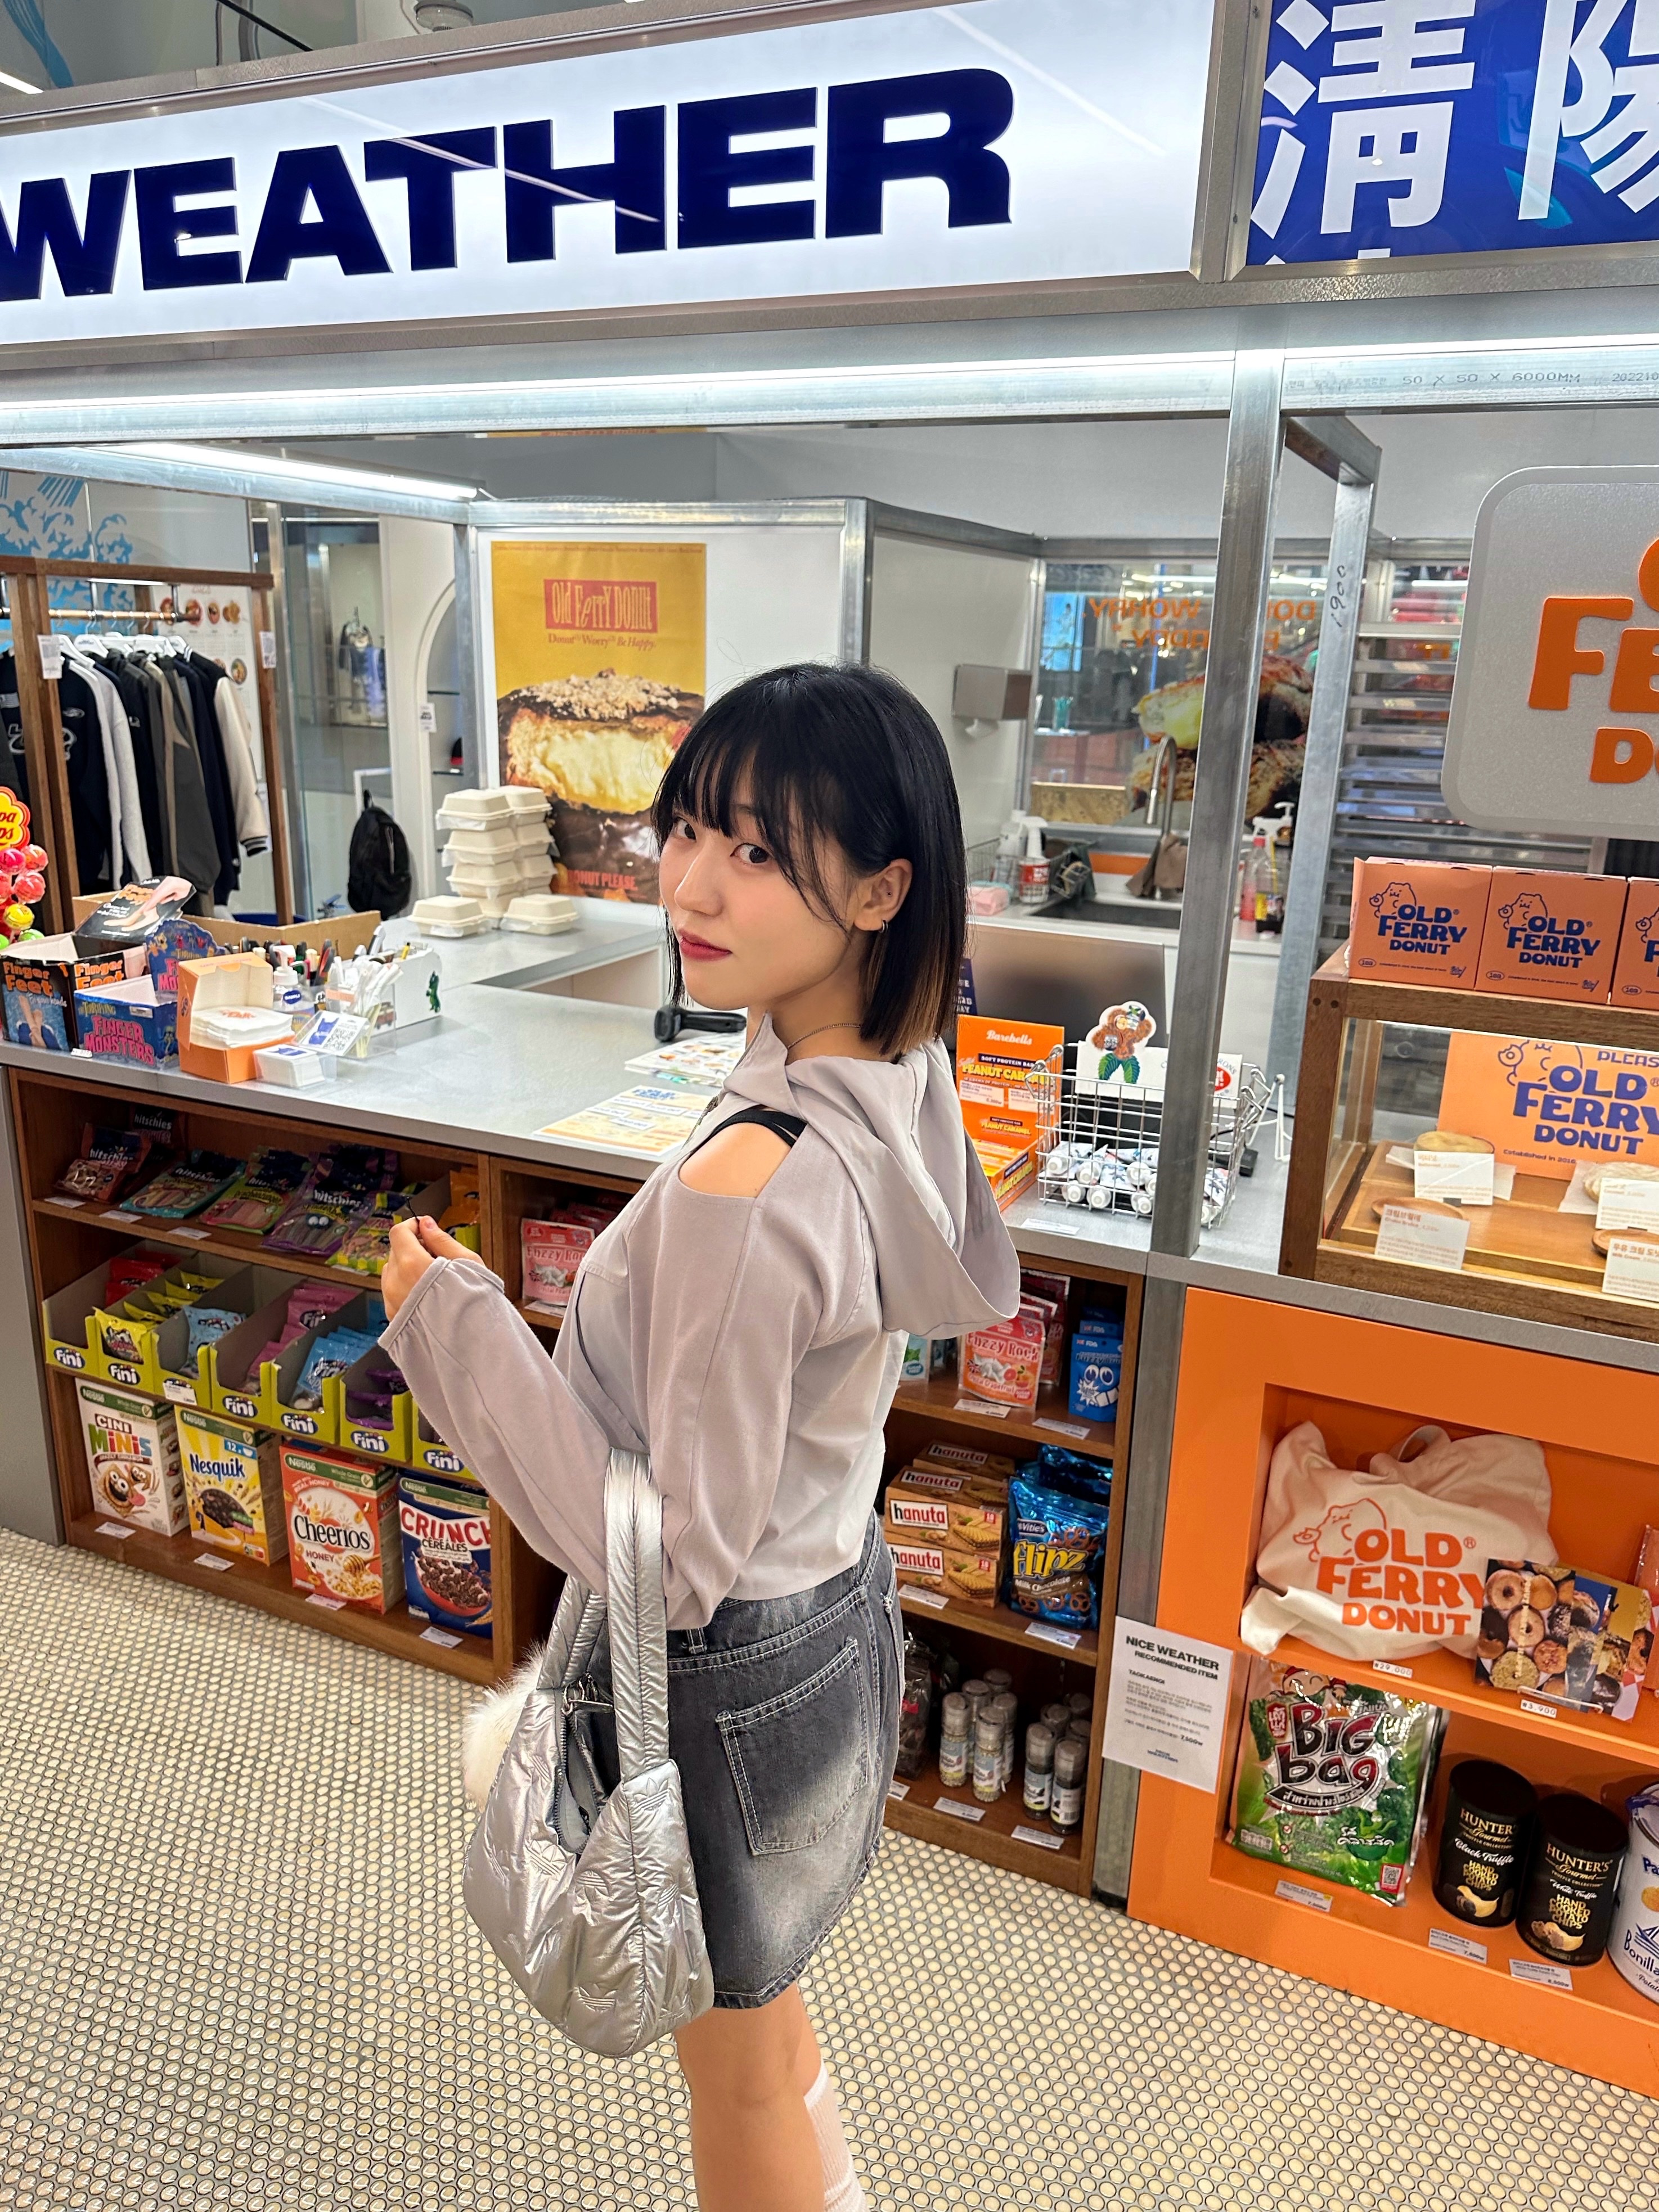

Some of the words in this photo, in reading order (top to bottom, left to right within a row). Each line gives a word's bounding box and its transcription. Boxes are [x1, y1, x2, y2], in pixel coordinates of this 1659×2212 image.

[0, 73, 1014, 302] WEATHER
[1397, 904, 1451, 923] OLD
[1378, 914, 1467, 943] FERRY
[1527, 915, 1585, 936] OLD
[1390, 940, 1450, 955] DONUT
[1507, 927, 1600, 956] FERRY
[3, 961, 50, 979] Finger
[74, 959, 123, 977] Finger
[1519, 952, 1582, 968] DONUT
[6, 975, 53, 997] Feet
[92, 1015, 145, 1043] FINGER
[986, 1030, 1033, 1045] Barebells
[84, 1032, 155, 1067] MONSTERS
[1597, 1050, 1659, 1068] PLEAS
[962, 1063, 1004, 1078] PEANUT
[997, 1058, 1022, 1066] PROTEIN
[1549, 1065, 1648, 1101] OLD
[981, 1123, 1004, 1131] PEANUT
[1004, 1125, 1031, 1135] CARAMEL
[1534, 1124, 1644, 1155] DONUT
[967, 1332, 1005, 1353] Fuzzy
[1008, 1342, 1038, 1361] Rock
[56, 1349, 83, 1369] Fini
[110, 1365, 138, 1385] Fini
[225, 1397, 255, 1418] Fini
[96, 1415, 131, 1433] CINI
[283, 1413, 314, 1434] Fini
[227, 1441, 237, 1453] 12
[353, 1431, 386, 1453] Fini
[426, 1450, 465, 1472] Fini
[932, 1445, 986, 1462] hanuta
[190, 1453, 245, 1482] Nesquik
[904, 1472, 960, 1489] hanuta
[894, 1503, 945, 1524] hanuta
[294, 1515, 370, 1551] Cheerios
[305, 1549, 335, 1564] HONEY
[891, 1546, 941, 1569] hanuta
[1013, 1540, 1087, 1577] flipz
[1354, 1529, 1463, 1568] OLD
[1015, 1578, 1031, 1590] Milk
[1032, 1576, 1071, 1591] Chocolate
[1317, 1556, 1484, 1610] FERRY
[1342, 1602, 1471, 1635] DONUT
[1126, 1636, 1155, 1652] NICE
[1157, 1644, 1220, 1670] WEATHER
[1135, 1650, 1197, 1674] RECOMMENDED
[1198, 1670, 1219, 1680] ITEM
[1275, 1742, 1379, 1786] bag
[1460, 1808, 1516, 1835] HUNTER'
[1454, 1837, 1482, 1858] Black
[1482, 1852, 1514, 1866] Truffle
[1546, 1842, 1609, 1872] HUNTER'S
[1463, 1863, 1499, 1880] COOKED
[1469, 1860, 1495, 1873] HAND
[1465, 1877, 1492, 1891] CHIPS
[1550, 1878, 1574, 1895] White
[1574, 1889, 1598, 1899] Truffle
[1549, 1898, 1591, 1917] COOKED
[1557, 1894, 1586, 1910] HAND
[1552, 1913, 1582, 1930] CHIPS
